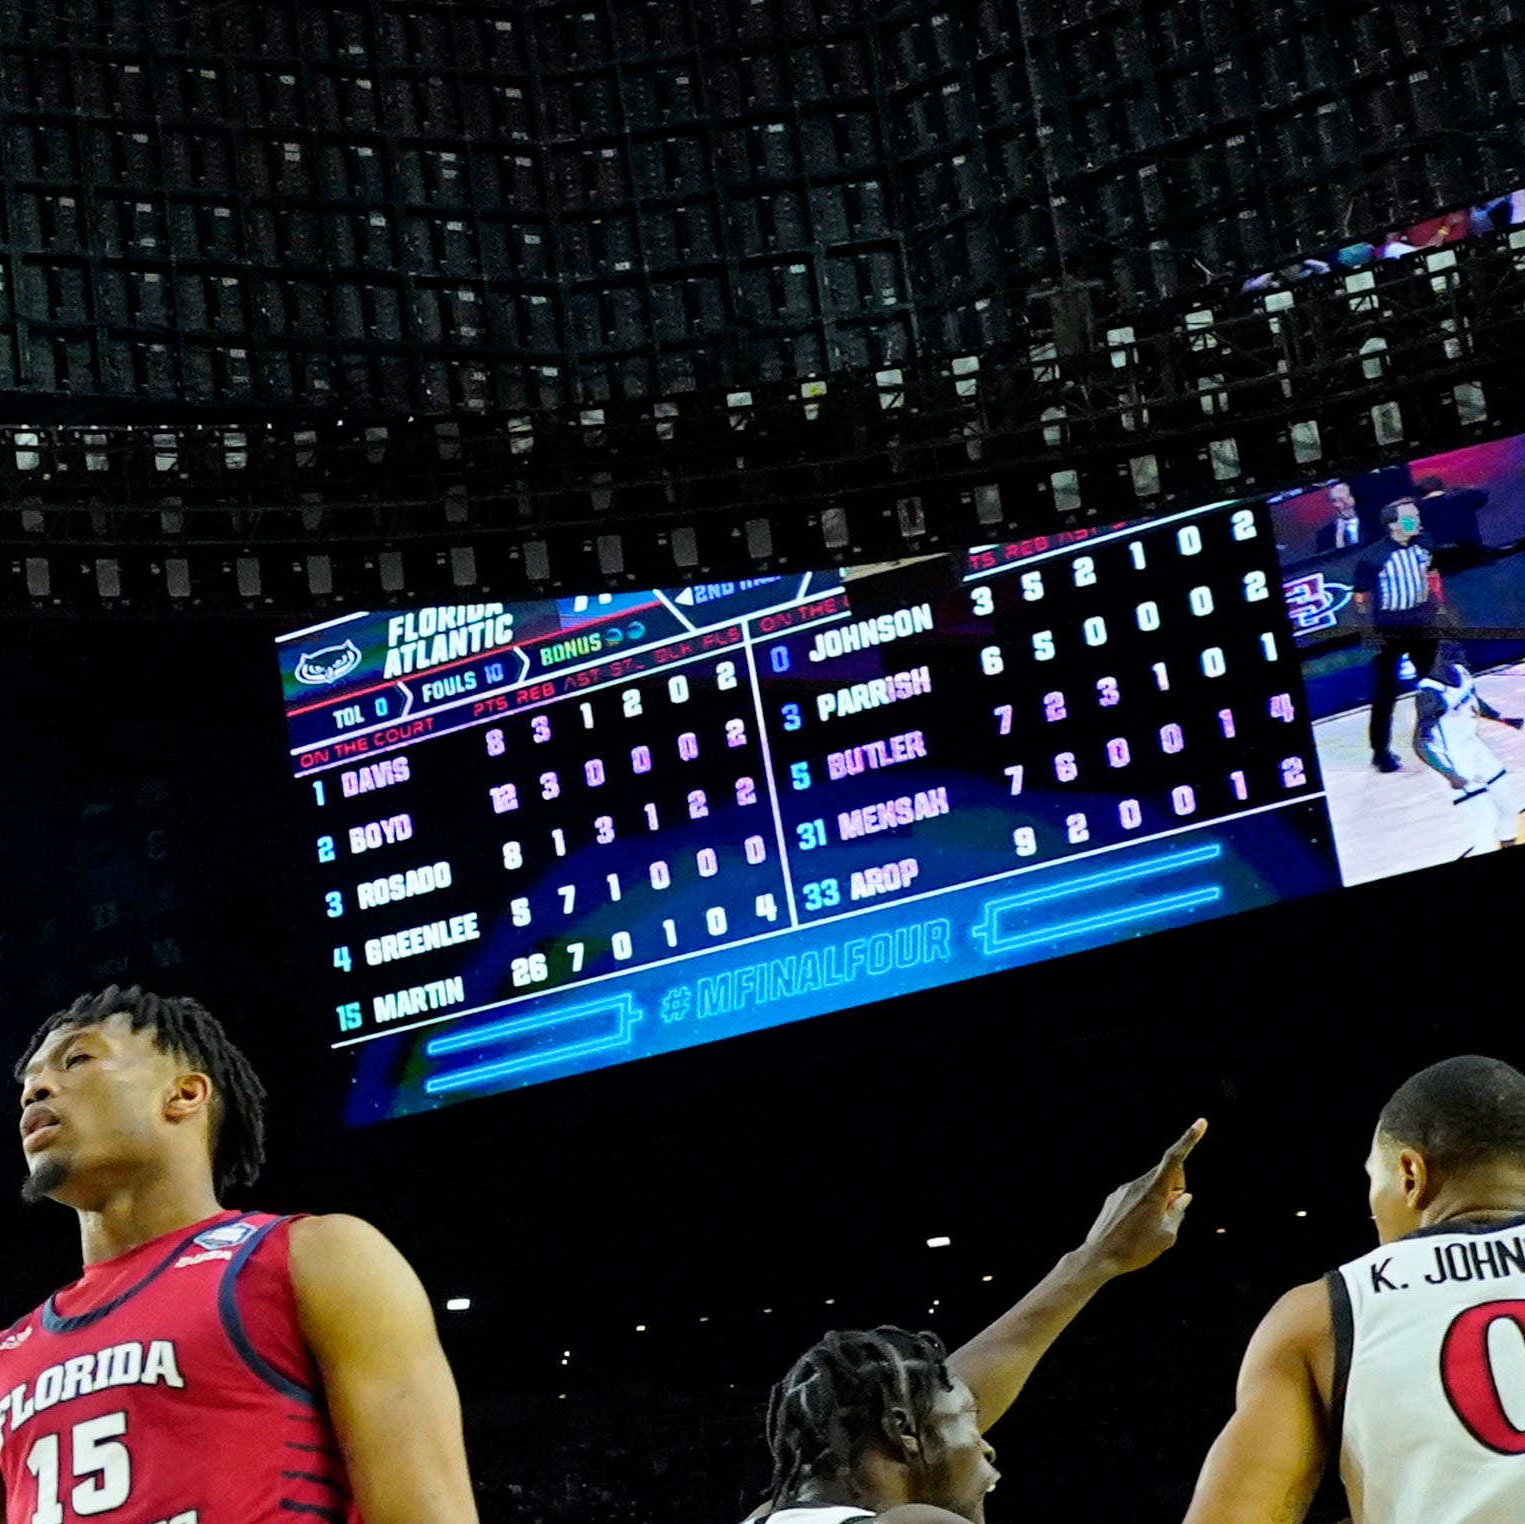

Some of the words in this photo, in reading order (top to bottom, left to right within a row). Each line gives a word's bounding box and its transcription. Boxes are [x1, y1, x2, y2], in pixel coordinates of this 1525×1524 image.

[383, 613, 514, 679] ATLANTIC
[539, 632, 603, 666] BONUS
[758, 614, 793, 633] ON
[770, 645, 791, 673] 0
[809, 603, 934, 662] JOHNSON
[971, 587, 993, 615] 3
[1021, 571, 1044, 601] 5
[1073, 557, 1096, 586] 2
[1129, 542, 1145, 569] 1
[1178, 526, 1201, 555] 0
[1232, 510, 1256, 540] 2
[781, 703, 802, 731] 3
[816, 665, 932, 722] PARRISH
[981, 646, 1003, 675] 6
[1033, 631, 1055, 660] 5
[1084, 617, 1107, 646] 0
[1137, 602, 1159, 631] 0
[1190, 586, 1213, 616] 0
[1244, 571, 1268, 601] 2
[313, 781, 325, 805] 1
[341, 756, 410, 797] DAVIS
[486, 729, 505, 756] 8
[532, 716, 551, 743] 3
[580, 703, 593, 728] 1
[623, 689, 642, 717] 2
[668, 675, 689, 703] 0
[716, 661, 737, 690] 2
[333, 704, 366, 729] TOL
[374, 697, 390, 717] 0
[422, 671, 478, 702] FOULS
[483, 662, 505, 685] 10
[473, 695, 509, 717] PTS
[516, 682, 555, 704] REB
[563, 668, 600, 692] AST
[702, 627, 742, 649] FLS
[790, 760, 812, 791] 5
[826, 730, 928, 781] BUTLER
[994, 705, 1012, 734] 7
[1044, 692, 1066, 722] 2
[1097, 677, 1119, 706] 3
[1153, 663, 1169, 690] 1
[1202, 648, 1225, 677] 0
[1261, 633, 1277, 661] 1
[300, 750, 329, 768] ON
[333, 738, 369, 759] THE
[373, 717, 435, 746] COURT
[317, 836, 336, 863] 2
[349, 814, 413, 853] BOYD
[489, 783, 519, 814] 12
[540, 772, 560, 800] 3
[585, 759, 605, 786] 0
[631, 746, 651, 774] 0
[678, 733, 698, 761] 0
[726, 719, 746, 747] 2
[796, 818, 828, 850] 31
[837, 786, 950, 840] MENSAH
[1004, 765, 1023, 795] 7
[1054, 752, 1077, 782] 6
[1107, 738, 1130, 767] 0
[1160, 723, 1183, 753] 0
[1219, 709, 1235, 738] 1
[1269, 693, 1294, 722] 4
[326, 891, 344, 918] 3
[357, 861, 452, 909] ROSADO
[503, 841, 522, 869] 8
[552, 829, 565, 856] 1
[595, 816, 615, 844] 3
[644, 803, 658, 830] 1
[688, 790, 709, 819] 2
[735, 777, 757, 806] 2
[802, 877, 841, 911] 33
[850, 857, 919, 901] AROP
[1013, 827, 1036, 856] 9
[1065, 813, 1089, 843] 2
[1118, 799, 1142, 829] 0
[1172, 785, 1195, 815] 0
[1231, 771, 1247, 800] 1
[1279, 757, 1306, 787] 2
[333, 946, 352, 972] 4
[365, 912, 480, 966] GREENLEE
[511, 897, 531, 926] 5
[557, 885, 575, 914] 7
[607, 874, 621, 901] 1
[649, 861, 670, 890] 0
[696, 848, 718, 877] 0
[744, 835, 767, 864] 0
[336, 1001, 363, 1032] 15
[373, 976, 465, 1022] MARTIN
[511, 953, 548, 987] 26
[567, 943, 584, 971] 7
[612, 931, 632, 960] 0
[662, 919, 683, 947] 1
[705, 906, 728, 937] 0
[756, 893, 777, 922] 4
[661, 918, 952, 1024] #MFINALFOUR
[1370, 1256, 1410, 1294] K.
[1424, 1236, 1525, 1285] JOHN
